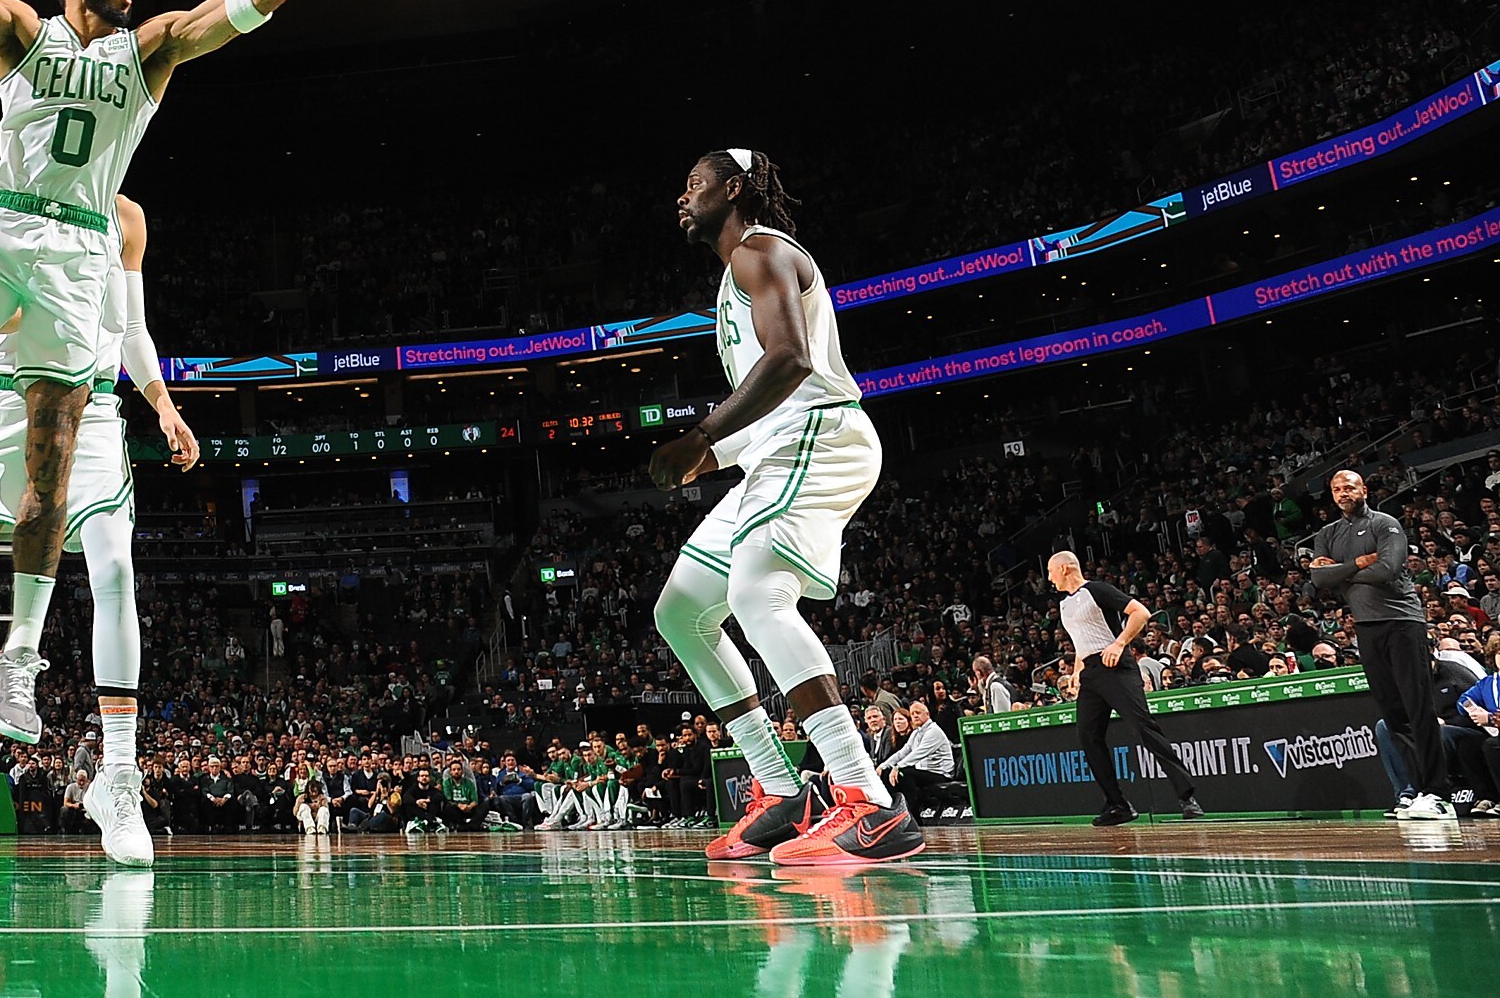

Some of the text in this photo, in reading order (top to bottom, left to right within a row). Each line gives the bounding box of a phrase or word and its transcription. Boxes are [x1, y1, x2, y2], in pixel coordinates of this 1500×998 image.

[107, 36, 129, 46] VISTA
[32, 56, 130, 109] CELTICS
[51, 107, 97, 167] 0
[1280, 137, 1376, 179] Stretching
[1201, 178, 1252, 210] jetBlue
[1255, 229, 1479, 305] Stretch out with the most
[836, 275, 916, 305] Stretching
[333, 351, 381, 371] jetBlue
[406, 346, 486, 370] Stretching
[879, 373, 905, 391] out
[907, 363, 944, 386] with
[944, 358, 971, 378] the
[974, 349, 1016, 372] most
[1019, 331, 1090, 367] legroom
[1092, 330, 1108, 348] in
[1112, 318, 1168, 344] coach.
[642, 408, 661, 423] TD
[666, 405, 695, 418] Bank
[501, 427, 514, 438] 24
[548, 430, 555, 439] 2
[214, 436, 437, 457] 7 50 1/2 0/0 0 0 0
[541, 569, 574, 580] TD Bank
[273, 583, 306, 595] TD Bank
[1288, 724, 1378, 771] vistaprint
[984, 757, 997, 789] IF
[999, 753, 1058, 787] BOSTON
[1060, 748, 1096, 785] NEE
[1114, 745, 1136, 785] IT,
[1231, 736, 1259, 775] IT.
